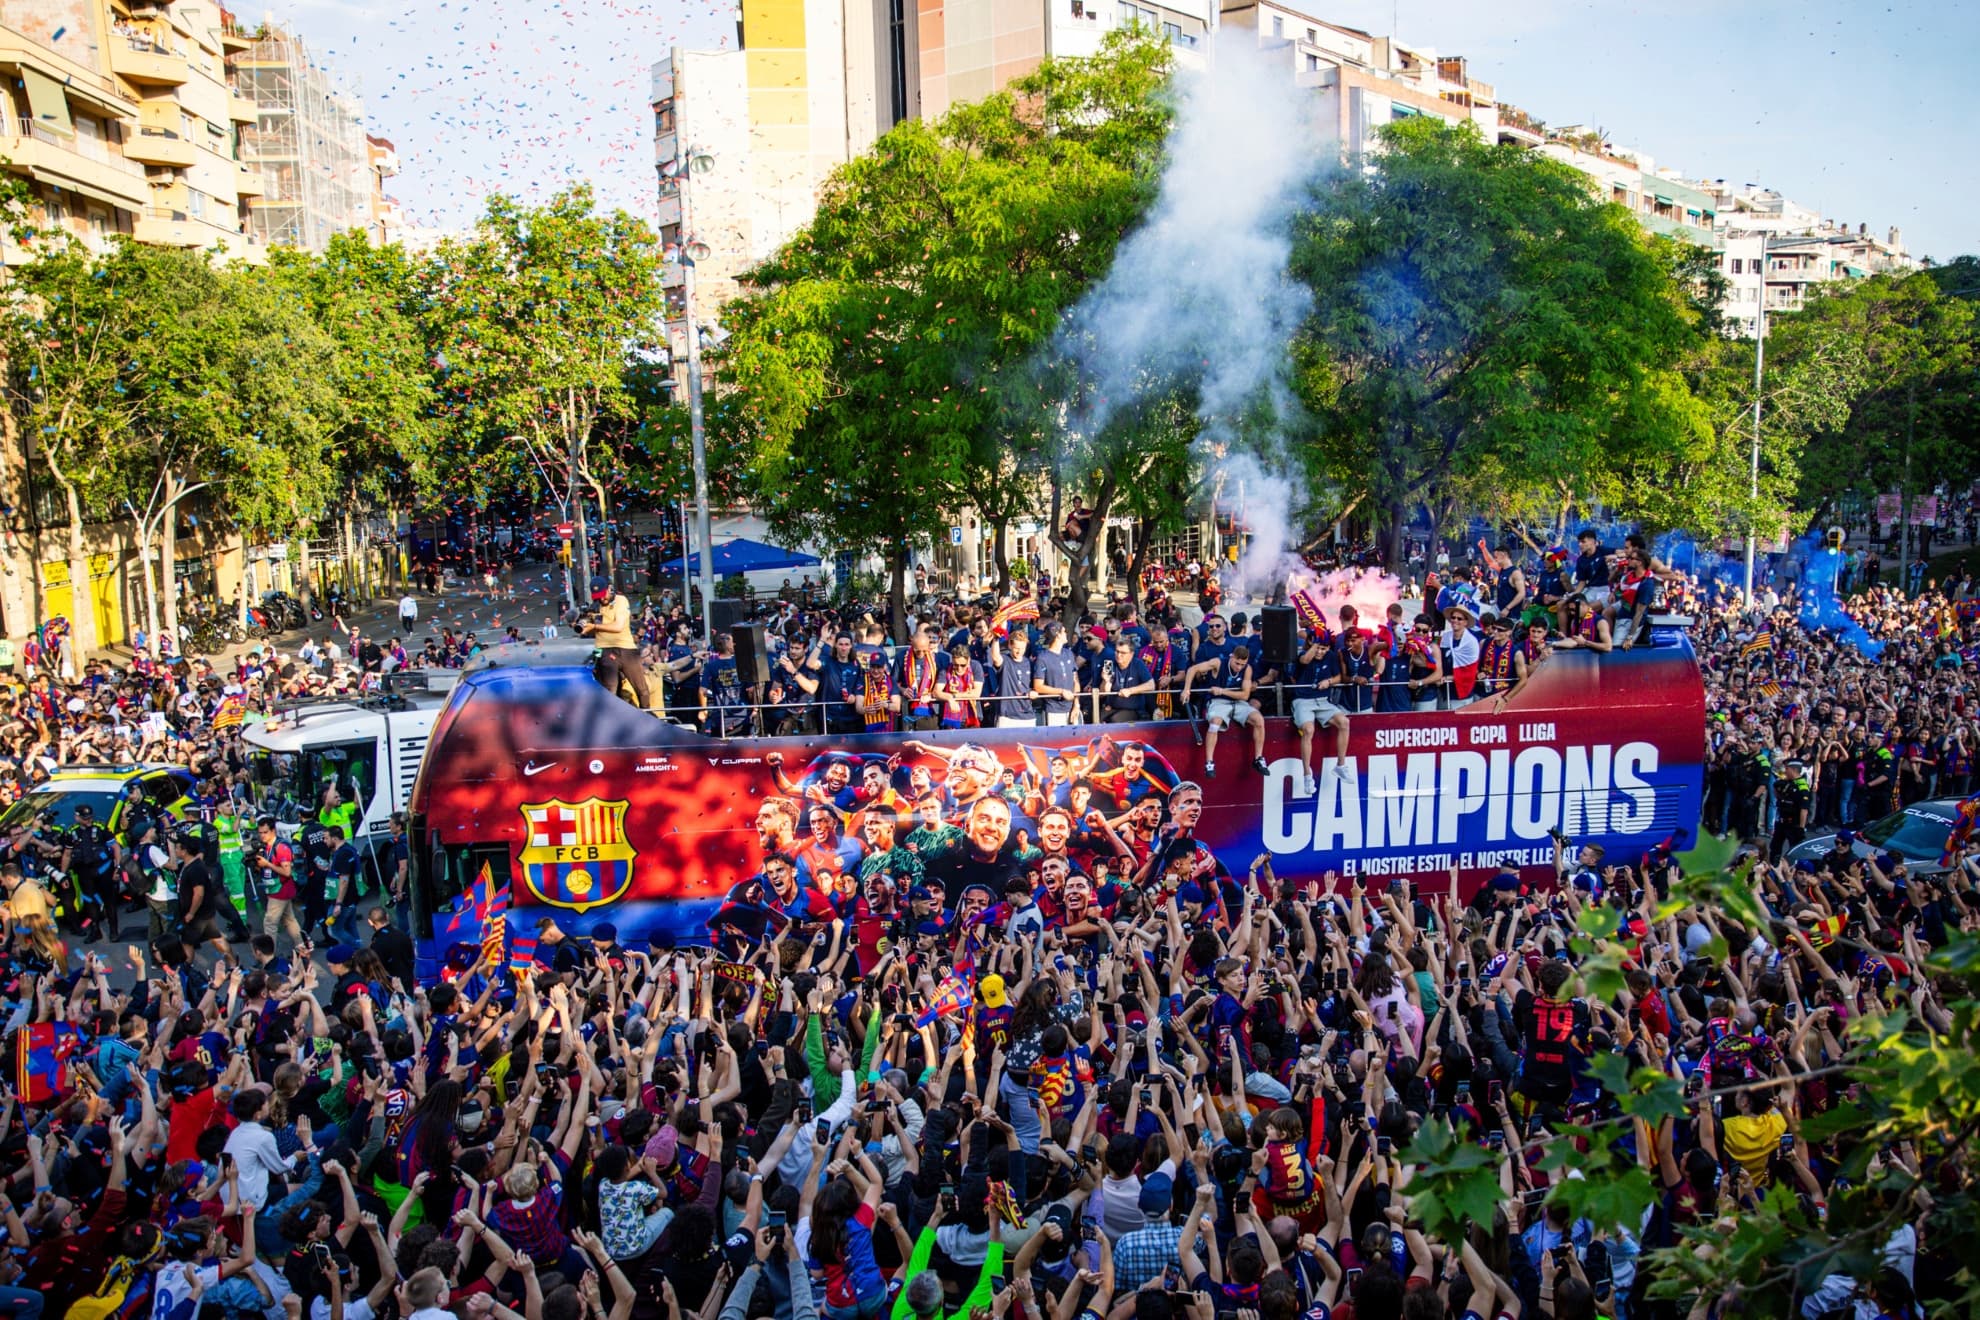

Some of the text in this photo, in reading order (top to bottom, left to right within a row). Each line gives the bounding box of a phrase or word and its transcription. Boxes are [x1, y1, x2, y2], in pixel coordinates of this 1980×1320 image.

[1375, 723, 1556, 748] SUPERCOPA COPA LLIGA
[1262, 742, 1659, 854] CAMPIONS
[556, 846, 599, 861] FCB
[1343, 859, 1357, 877] EL
[1361, 856, 1415, 876] NOSTRE
[1417, 853, 1452, 872] ESTIL
[1460, 852, 1474, 870] EL
[1532, 846, 1579, 865] LLEAT
[991, 1030, 1007, 1044] 10
[1533, 1008, 1573, 1042] 19
[1283, 1153, 1304, 1189] 3
